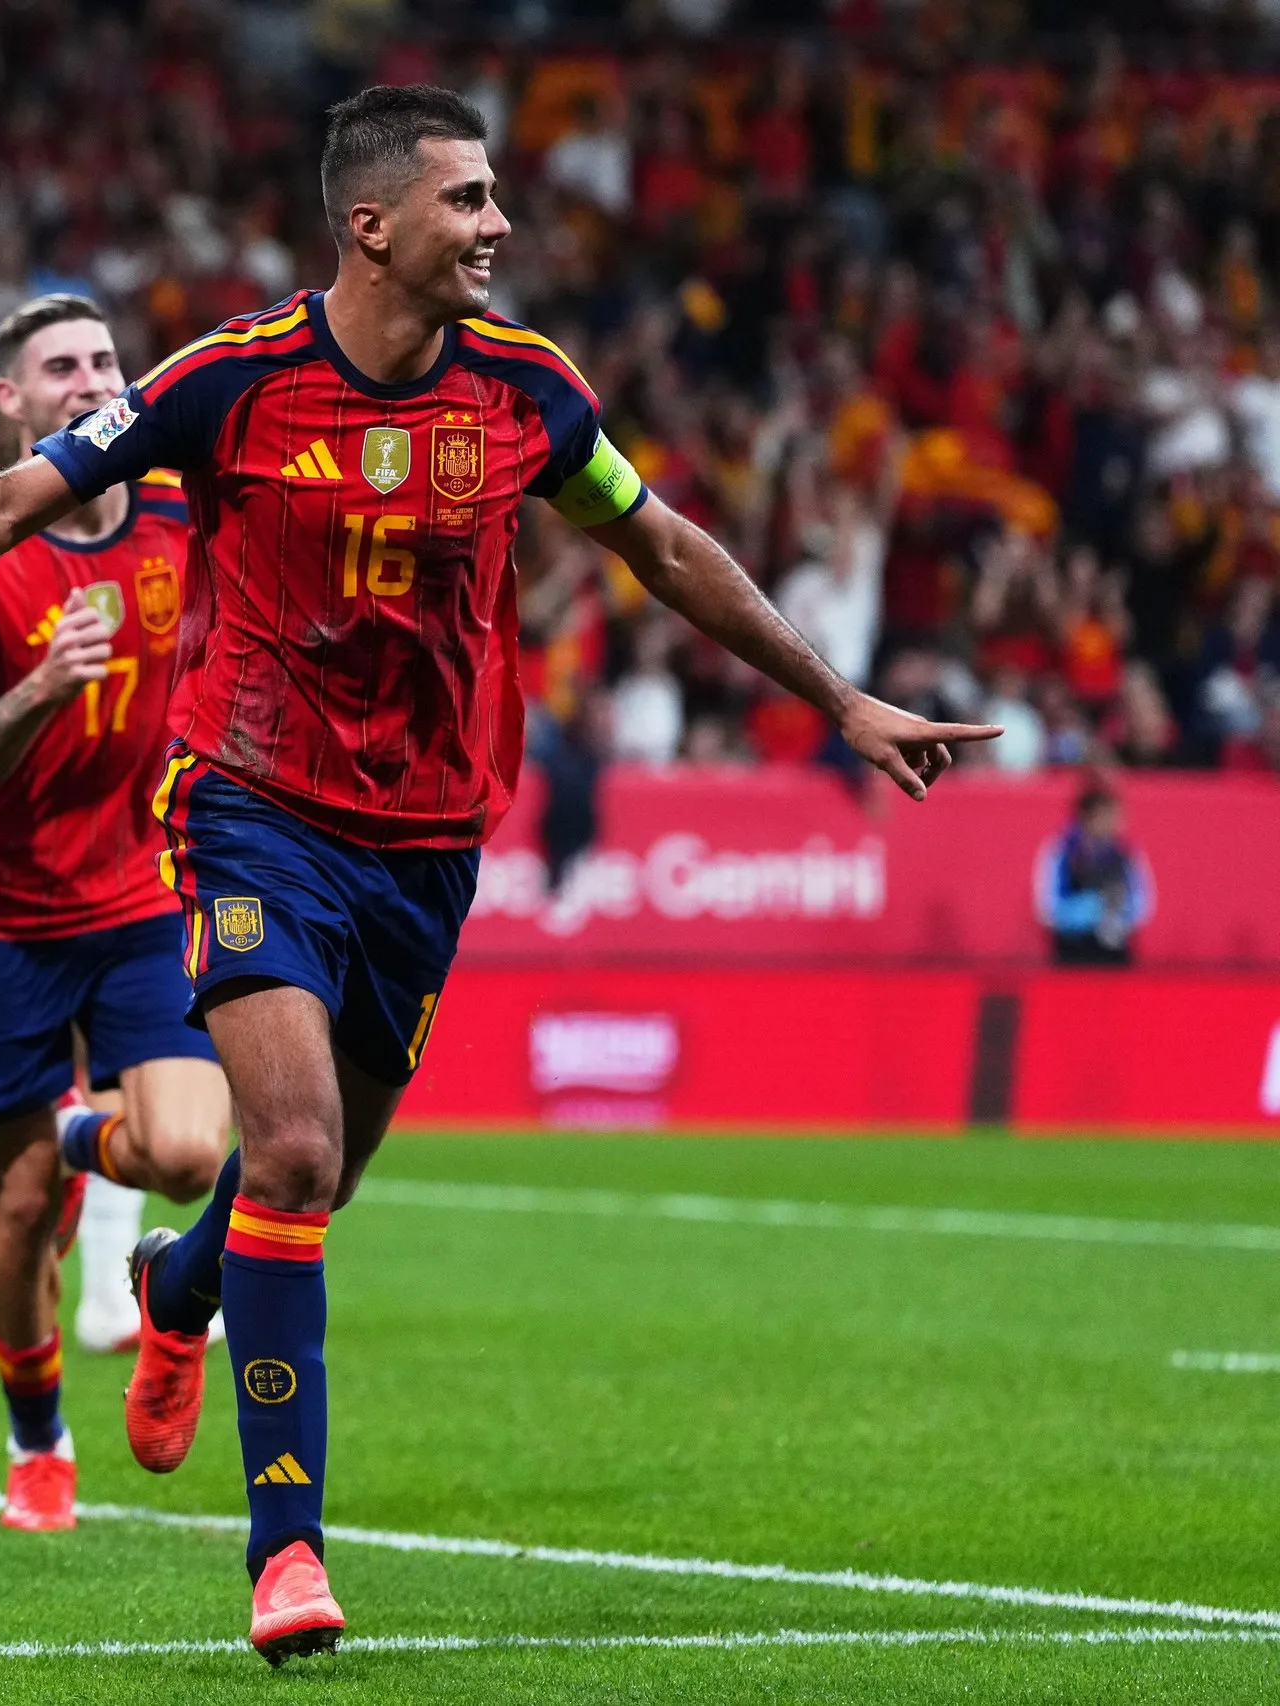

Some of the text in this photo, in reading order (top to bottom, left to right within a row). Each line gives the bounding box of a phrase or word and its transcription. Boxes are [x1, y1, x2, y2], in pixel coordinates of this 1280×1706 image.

[375, 468, 396, 477] FIFA
[590, 459, 622, 502] RESPEC
[343, 514, 416, 598] 16
[84, 656, 139, 737] 17
[645, 832, 887, 919] Gemini
